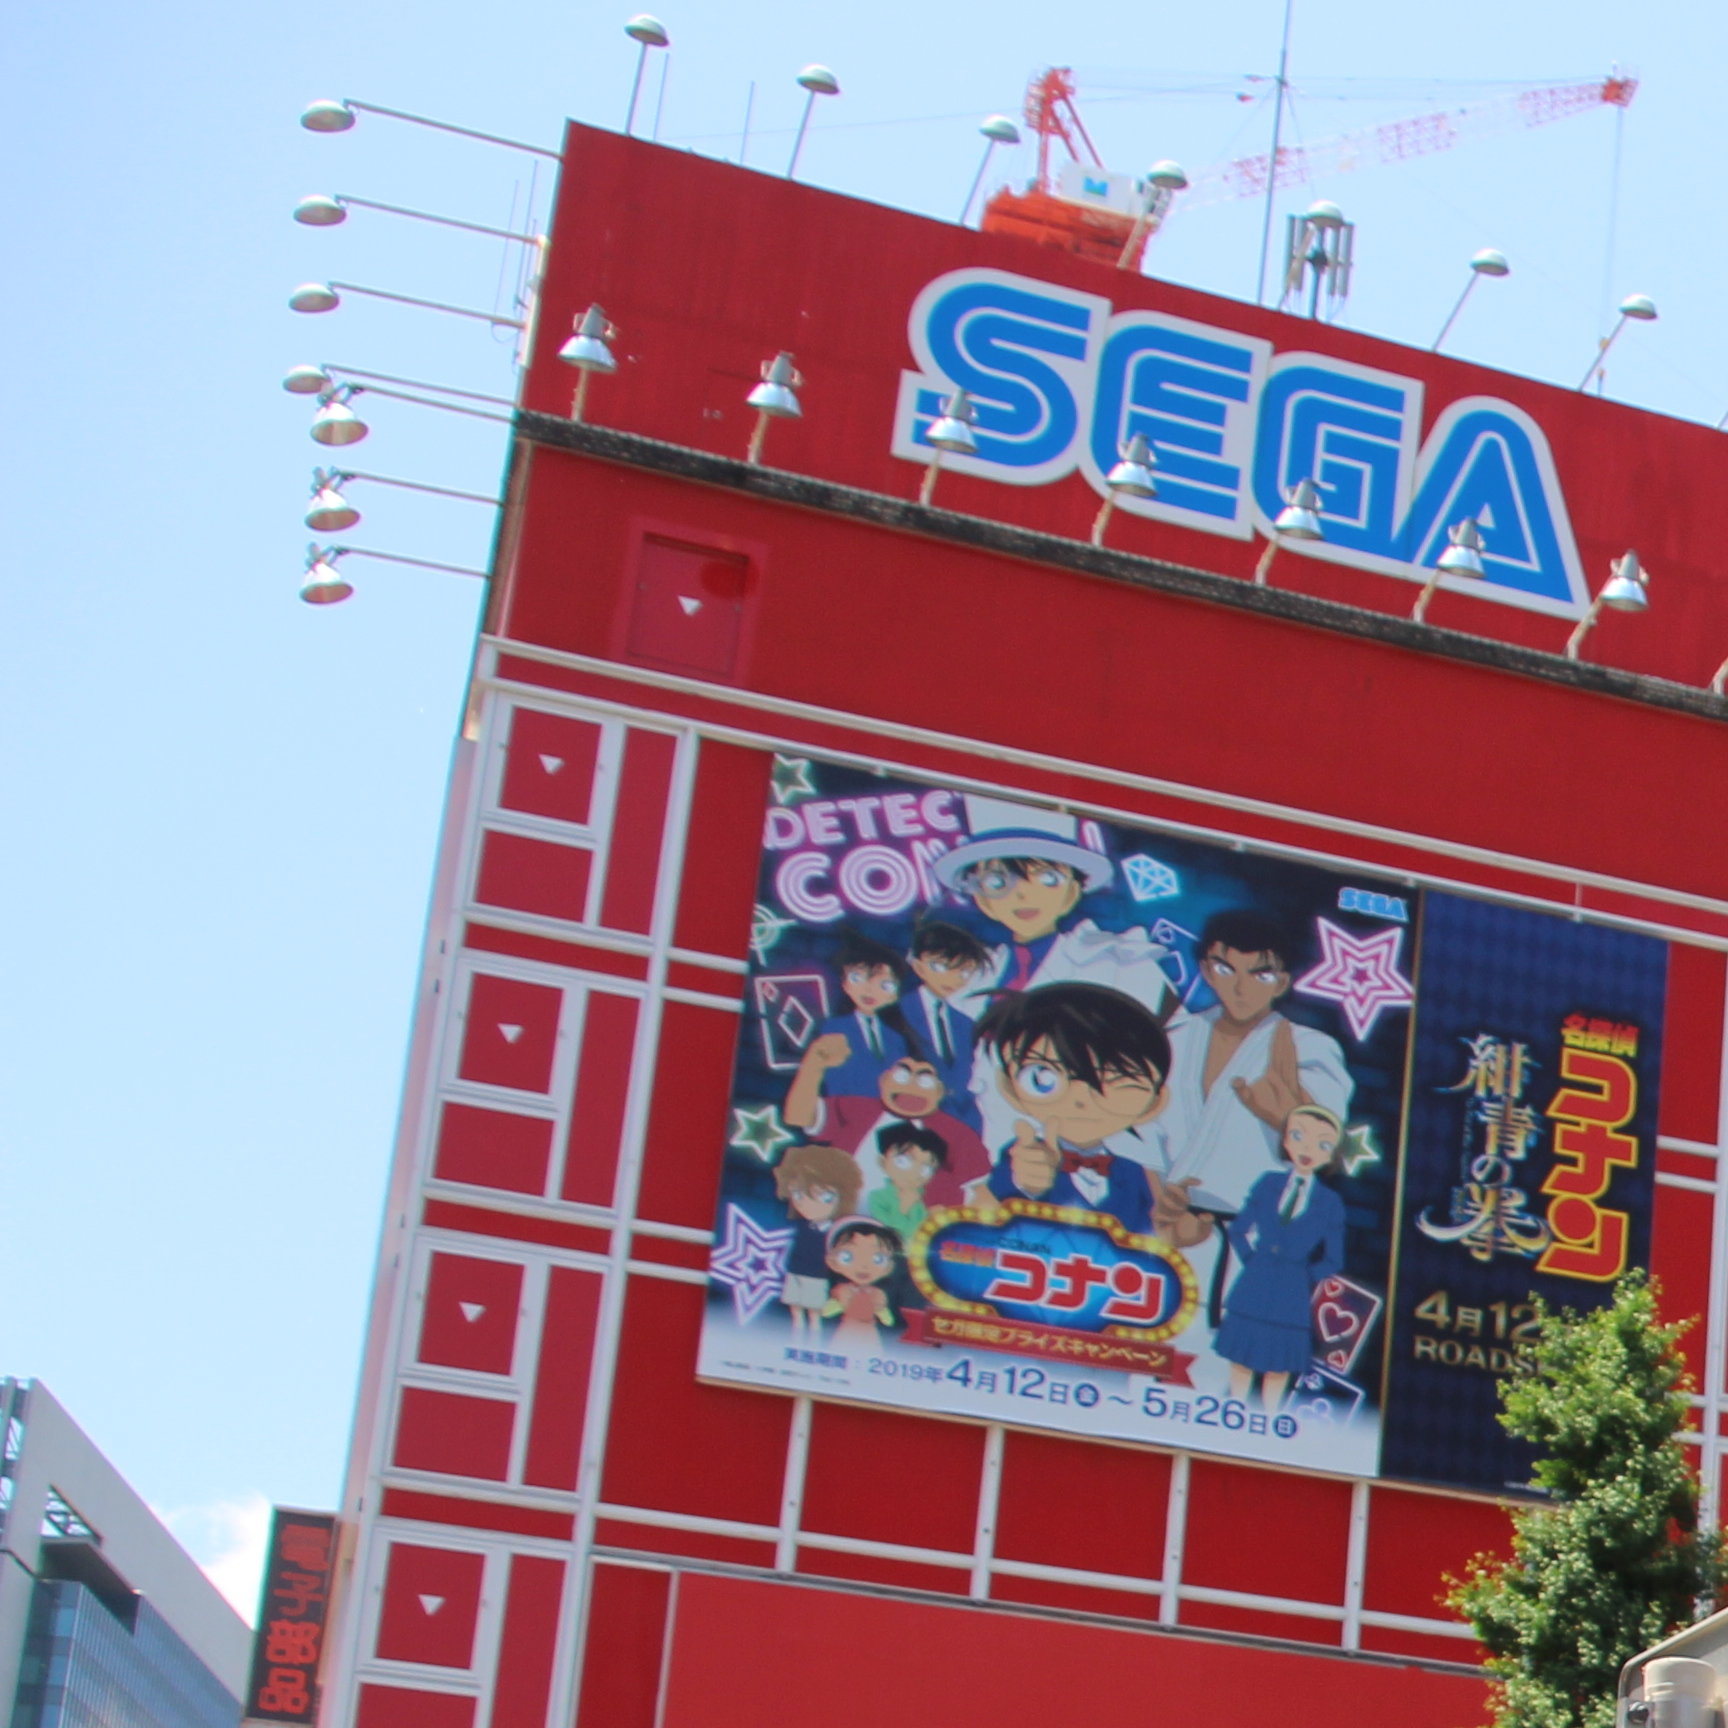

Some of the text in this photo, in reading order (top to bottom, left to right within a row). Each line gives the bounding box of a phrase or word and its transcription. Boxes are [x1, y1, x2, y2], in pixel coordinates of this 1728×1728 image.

[892, 265, 1592, 622] SEGA
[1534, 1046, 1638, 1283] コナン
[983, 1247, 1166, 1324] コナン
